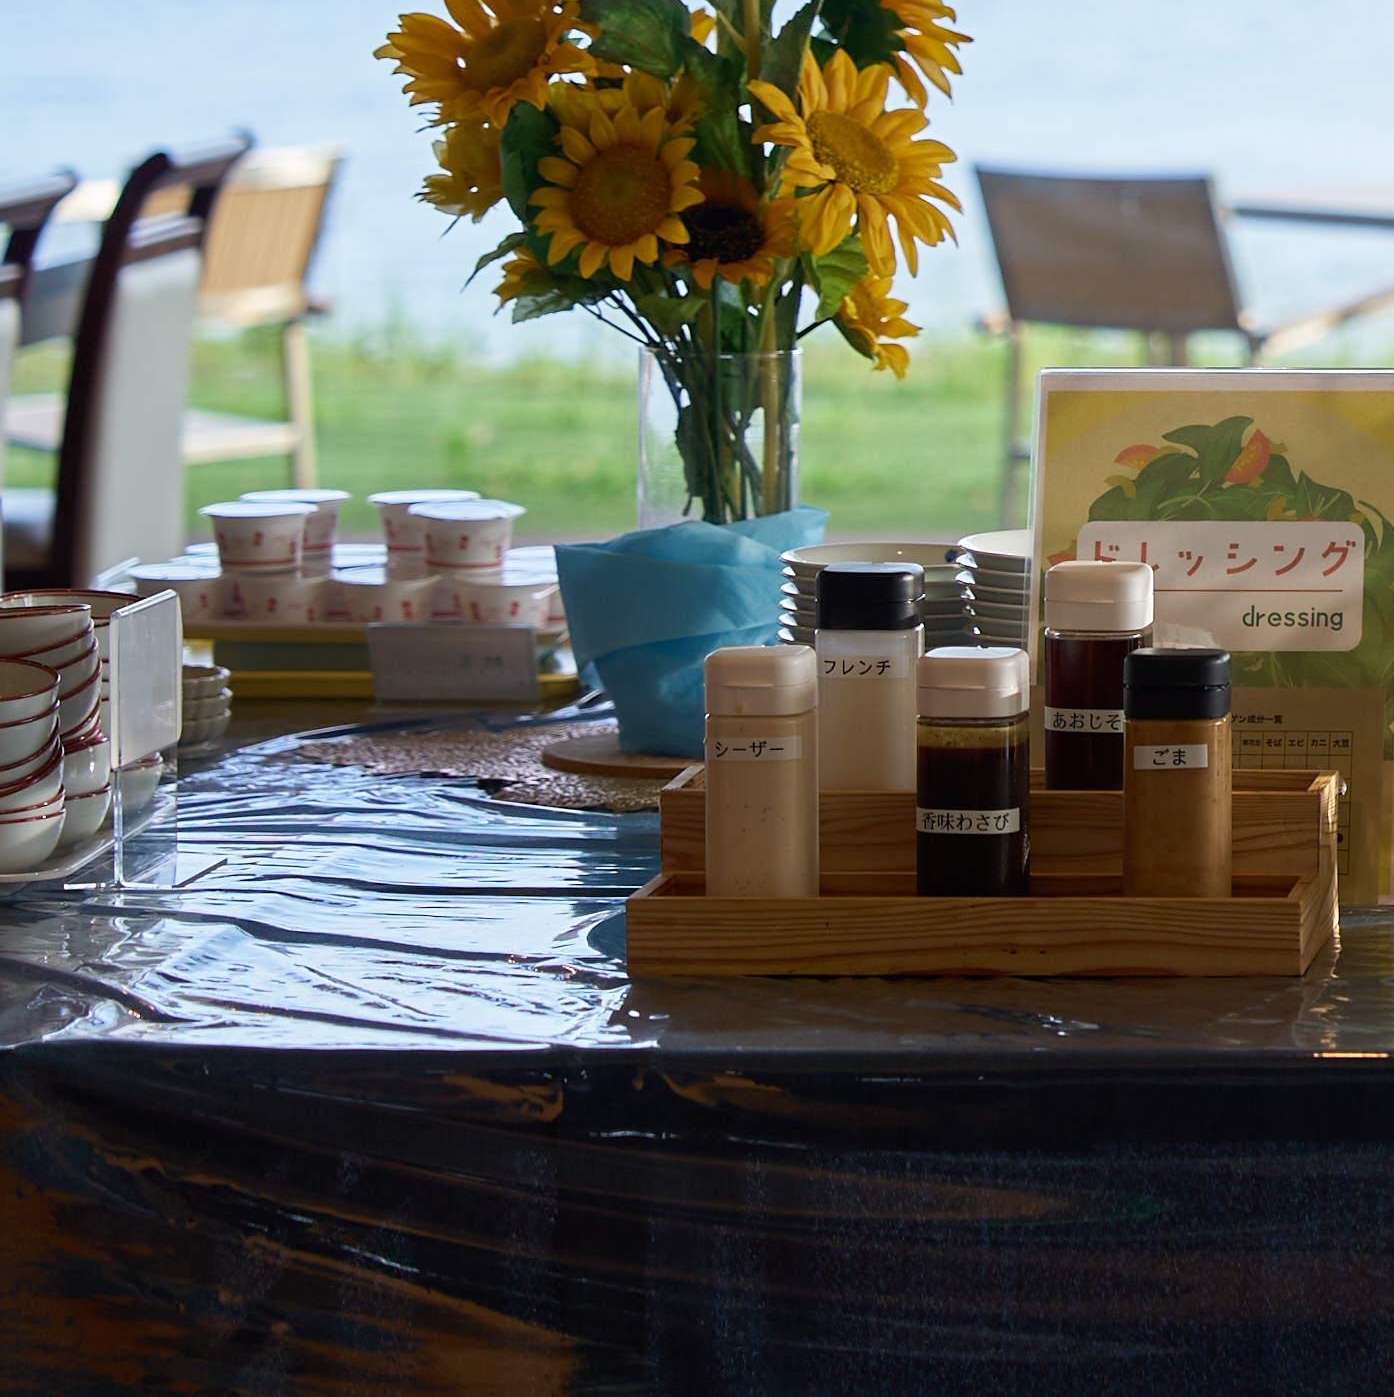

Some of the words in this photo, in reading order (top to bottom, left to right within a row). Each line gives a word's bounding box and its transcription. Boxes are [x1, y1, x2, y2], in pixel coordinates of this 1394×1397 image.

[1242, 605, 1344, 631] dressing
[823, 659, 891, 676] フレンチ
[1052, 712, 1121, 731] あおじそ
[715, 740, 785, 758] シーザー
[1265, 738, 1283, 747] そば
[1310, 738, 1327, 747] カニ
[1333, 739, 1350, 747] 大豆
[1152, 748, 1187, 766] ごま
[921, 812, 1010, 831] 香味わさび
